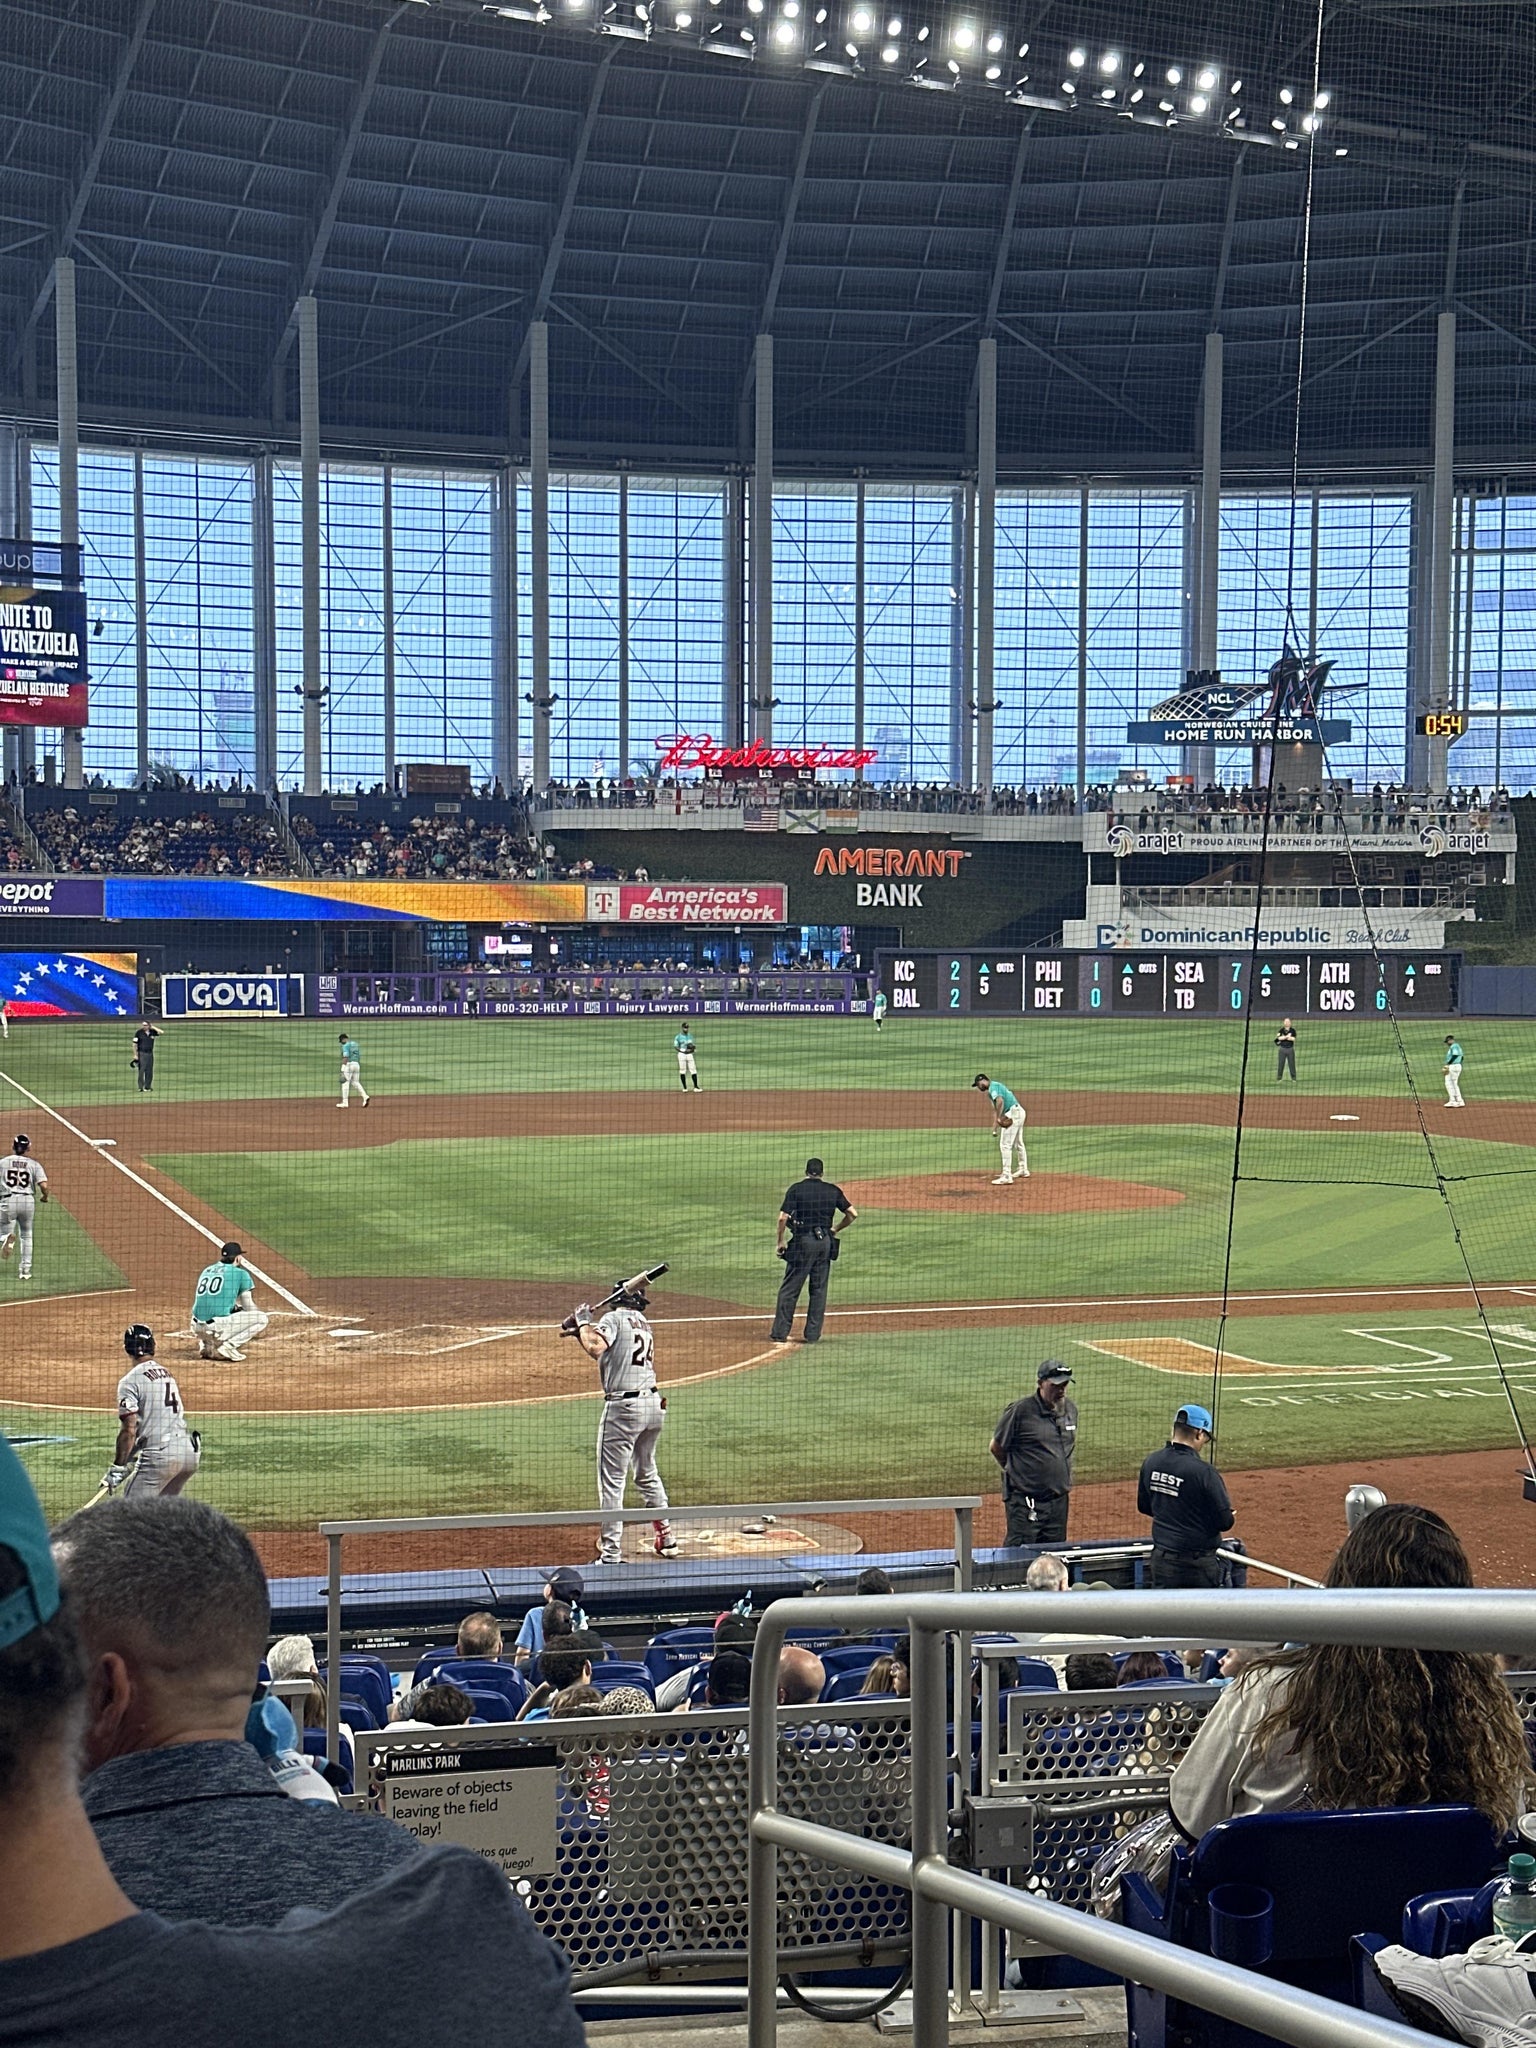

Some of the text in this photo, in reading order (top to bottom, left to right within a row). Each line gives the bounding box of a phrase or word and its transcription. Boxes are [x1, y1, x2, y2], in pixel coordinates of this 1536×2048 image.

[33, 605, 52, 630] TO
[1, 629, 79, 656] VENEZUELA
[30, 682, 70, 697] HERITAGE
[1208, 693, 1234, 704] NCL
[1425, 715, 1462, 735] 0:54
[1164, 730, 1209, 741] HOME
[1214, 729, 1246, 740] RUN
[655, 733, 878, 769] Budweiser
[1138, 828, 1184, 854] arajet
[1190, 838, 1413, 847] PROUD AIRLINE PARTNER OF THE Miami Marlins
[1448, 829, 1490, 854] arajet
[813, 847, 965, 877] AMERANT
[0, 882, 54, 904] epot
[646, 887, 758, 904] America's
[856, 883, 923, 907] BANK
[629, 903, 776, 920] Best Network
[1385, 929, 1411, 943] Club
[894, 961, 960, 982] KC 2
[1035, 961, 1099, 982] PHI 1
[1174, 962, 1242, 983] SEA 7
[1320, 963, 1350, 983] ATH
[191, 983, 274, 1008] GOYA
[980, 977, 989, 995] 5
[1122, 977, 1132, 996] 6
[1261, 978, 1271, 997] 5
[1405, 978, 1415, 997] 4
[893, 988, 960, 1008] BAL 2
[1034, 989, 1100, 1008] DET 0
[1174, 989, 1242, 1009] TB 0
[1320, 989, 1386, 1010] CWS 6
[343, 1003, 447, 1014] WernerHoffman.com
[495, 1003, 568, 1014] 800-320-HELP
[616, 1003, 645, 1014] Injury
[649, 1003, 689, 1014] Lawyers
[735, 1002, 835, 1012] WernerHoffman.com
[6, 1170, 30, 1188] 53
[198, 1276, 222, 1294] 80
[165, 1383, 178, 1413] 4
[1240, 1387, 1506, 1407] OFFICIAL
[1151, 1471, 1184, 1487] BEST
[270, 1759, 300, 1773] BILLY
[391, 1754, 461, 1772] MARLINS PARK
[392, 1779, 513, 1800] Beware of objects
[392, 1798, 498, 1819] leaving the field
[410, 1822, 441, 1838] play!
[498, 1847, 518, 1858] que
[502, 1857, 534, 1871] juego!
